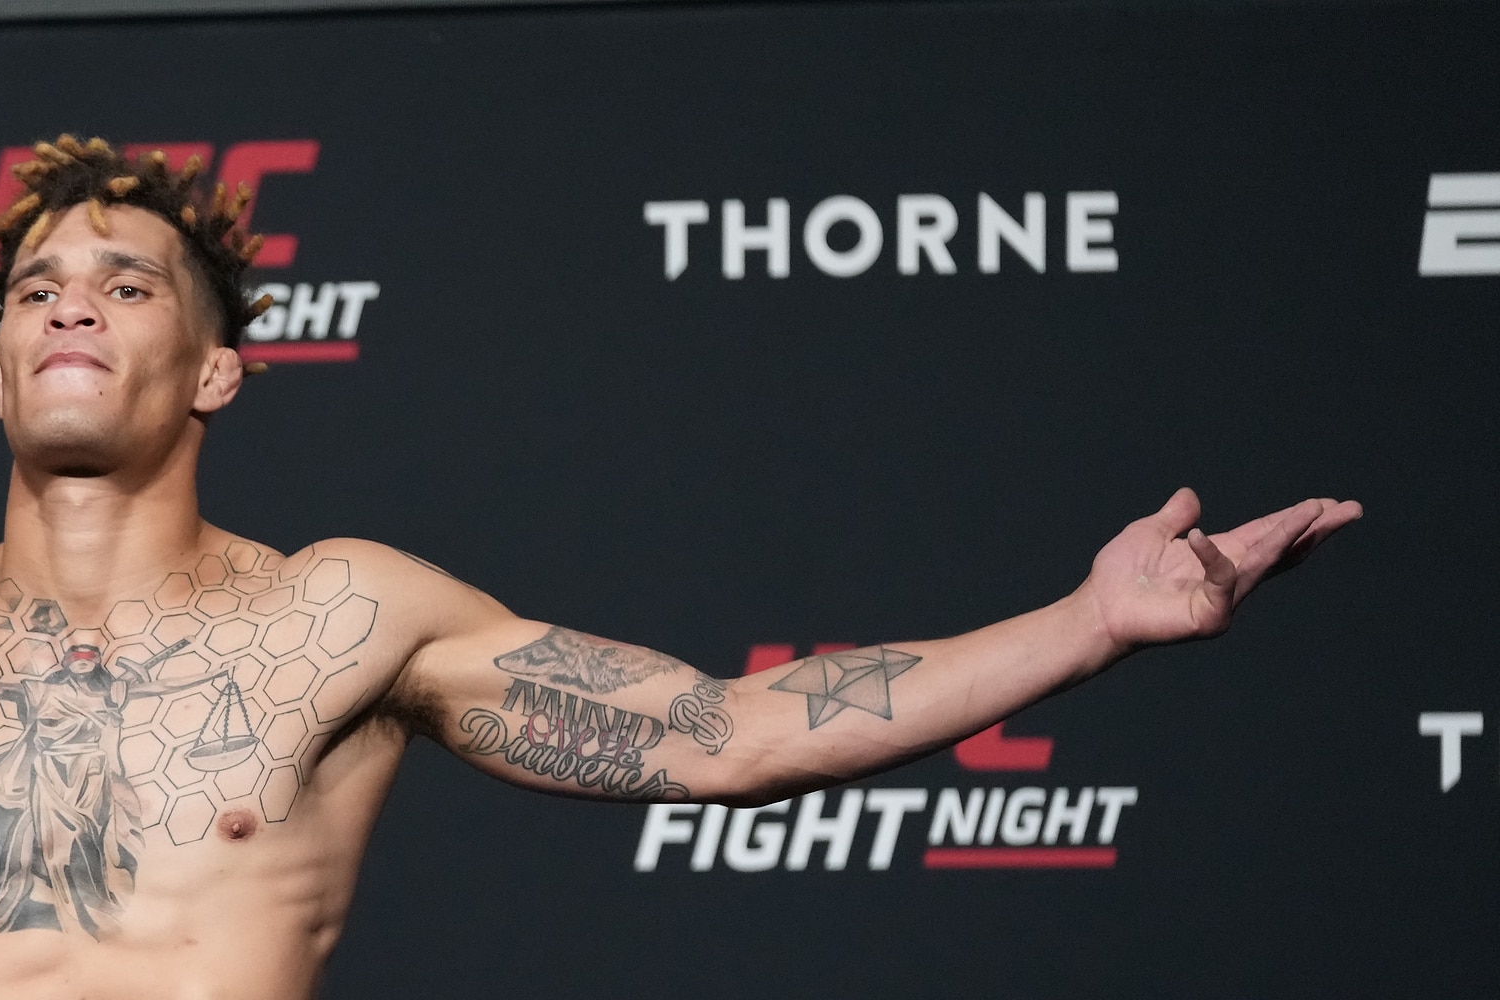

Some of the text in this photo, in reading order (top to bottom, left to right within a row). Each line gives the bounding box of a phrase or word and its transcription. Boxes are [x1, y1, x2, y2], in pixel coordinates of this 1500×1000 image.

[643, 190, 1119, 282] THORNE
[246, 281, 381, 341] GHT
[500, 677, 666, 751] MIND
[633, 785, 1138, 873] FIGHT NIGHT
